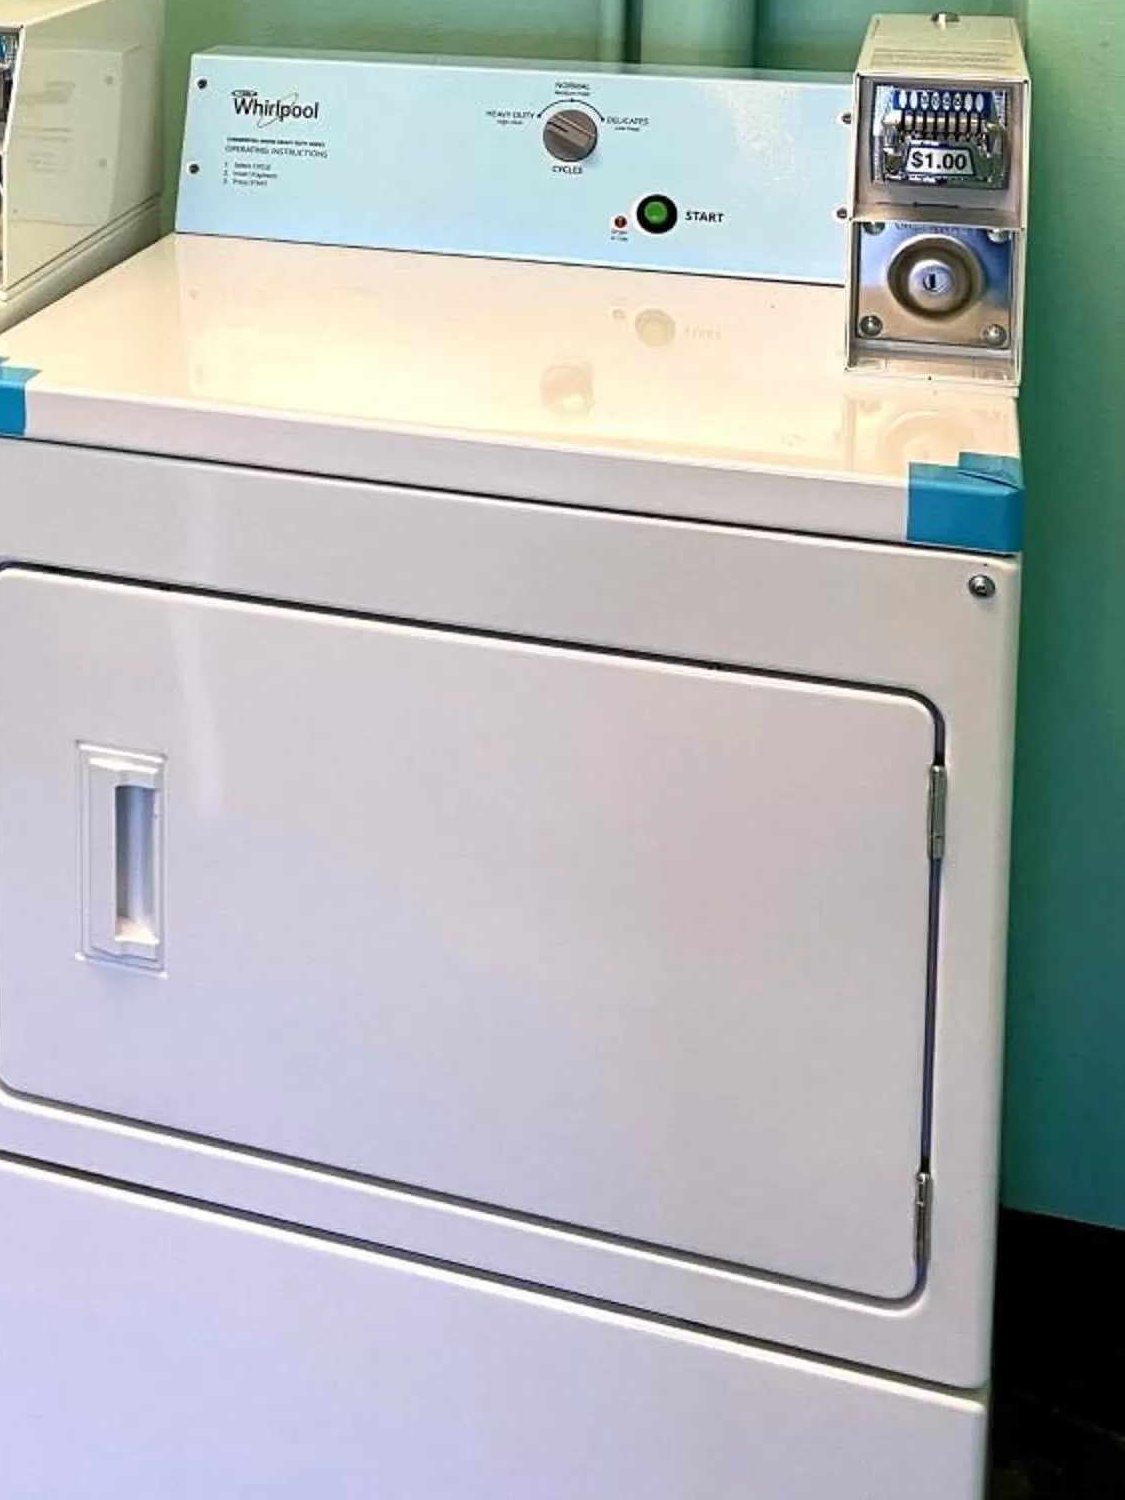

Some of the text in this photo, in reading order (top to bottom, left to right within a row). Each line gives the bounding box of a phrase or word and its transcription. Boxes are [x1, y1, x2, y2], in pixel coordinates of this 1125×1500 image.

[233, 97, 320, 122] Whirlpool
[552, 164, 584, 175] CYCLES
[910, 150, 968, 172] $1.00
[684, 209, 726, 224] START
